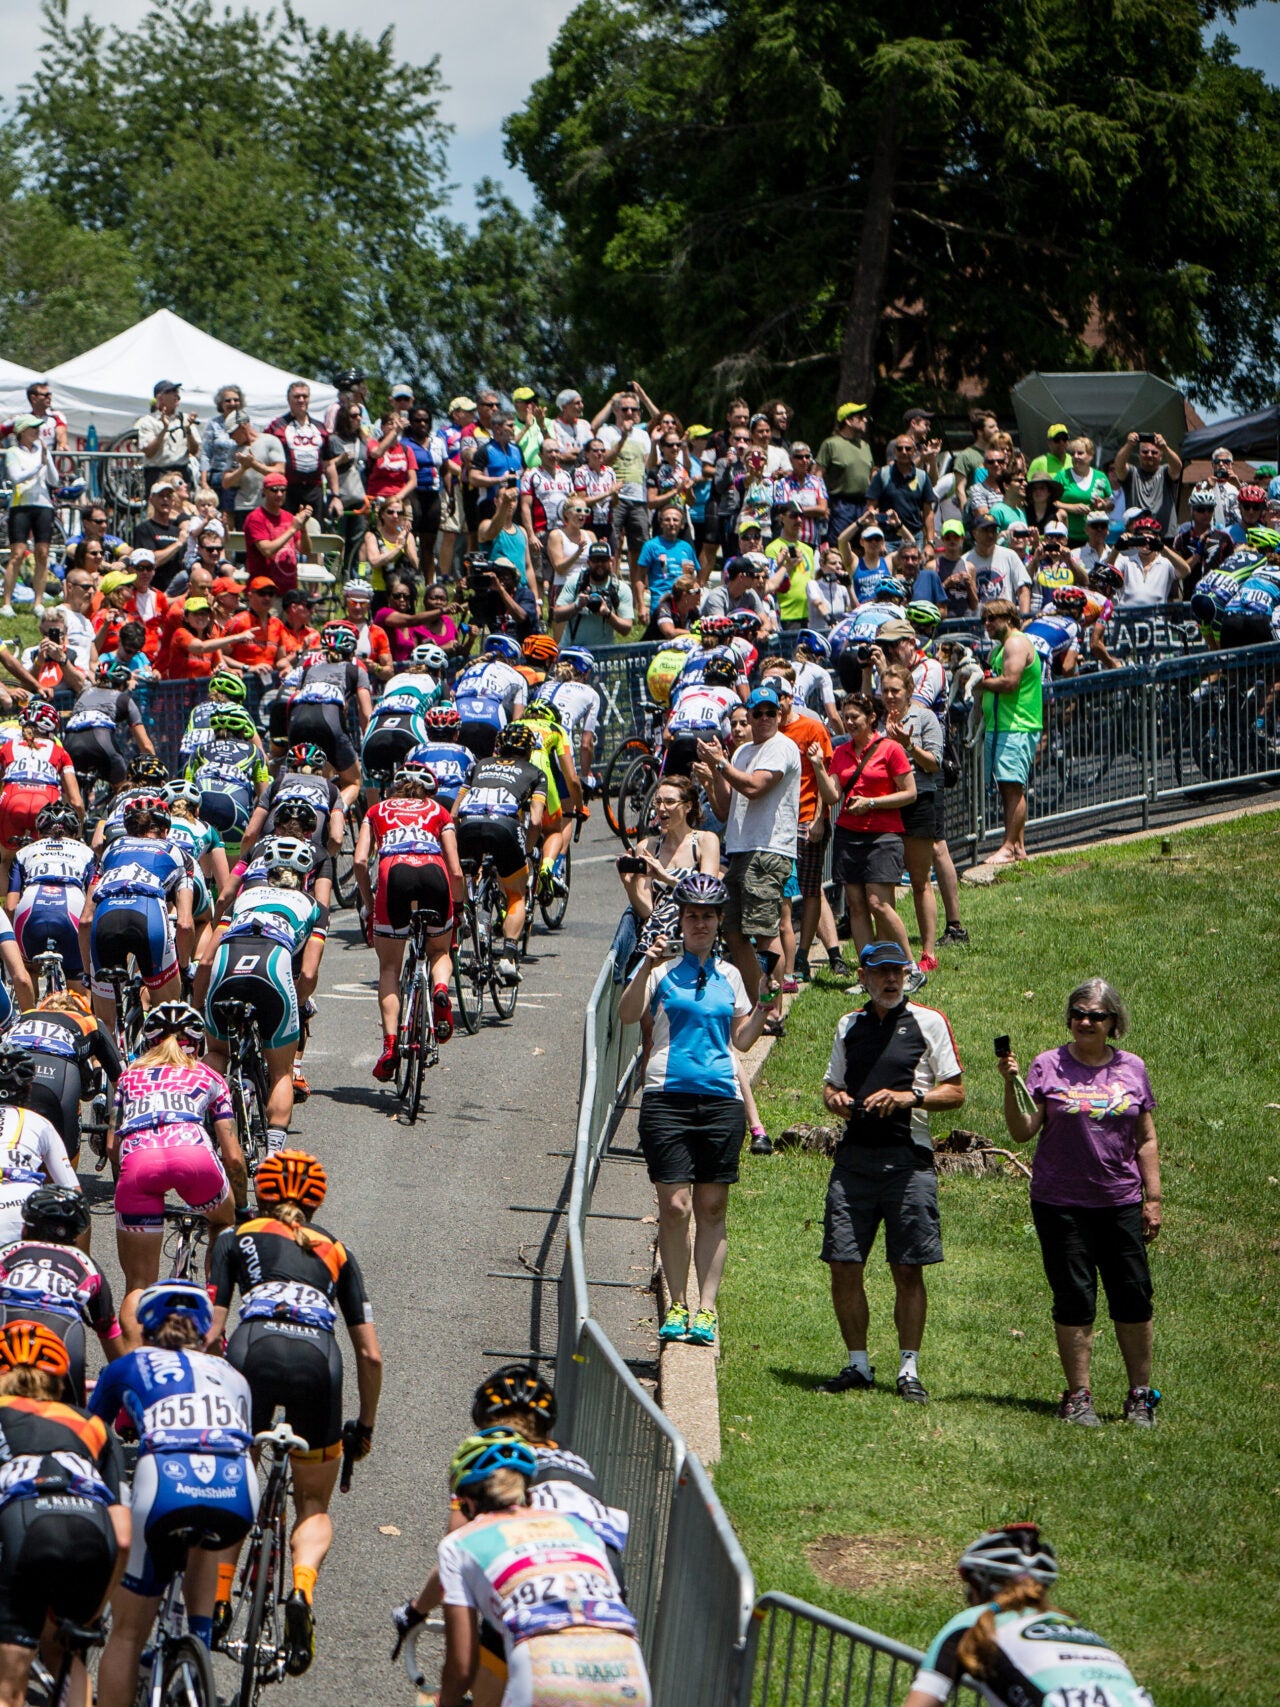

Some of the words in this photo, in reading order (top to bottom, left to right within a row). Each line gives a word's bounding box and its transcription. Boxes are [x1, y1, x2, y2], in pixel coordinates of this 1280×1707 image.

[591, 656, 647, 674] RESENTED
[700, 706, 714, 720] 16
[478, 769, 517, 784] HONDA
[481, 763, 523, 776] wiggle
[497, 788, 511, 804] 12
[39, 851, 77, 861] weber
[131, 862, 153, 884] 73
[159, 1090, 196, 1114] 186
[279, 1323, 321, 1337] KELLY
[175, 1482, 238, 1500] AegisShield
